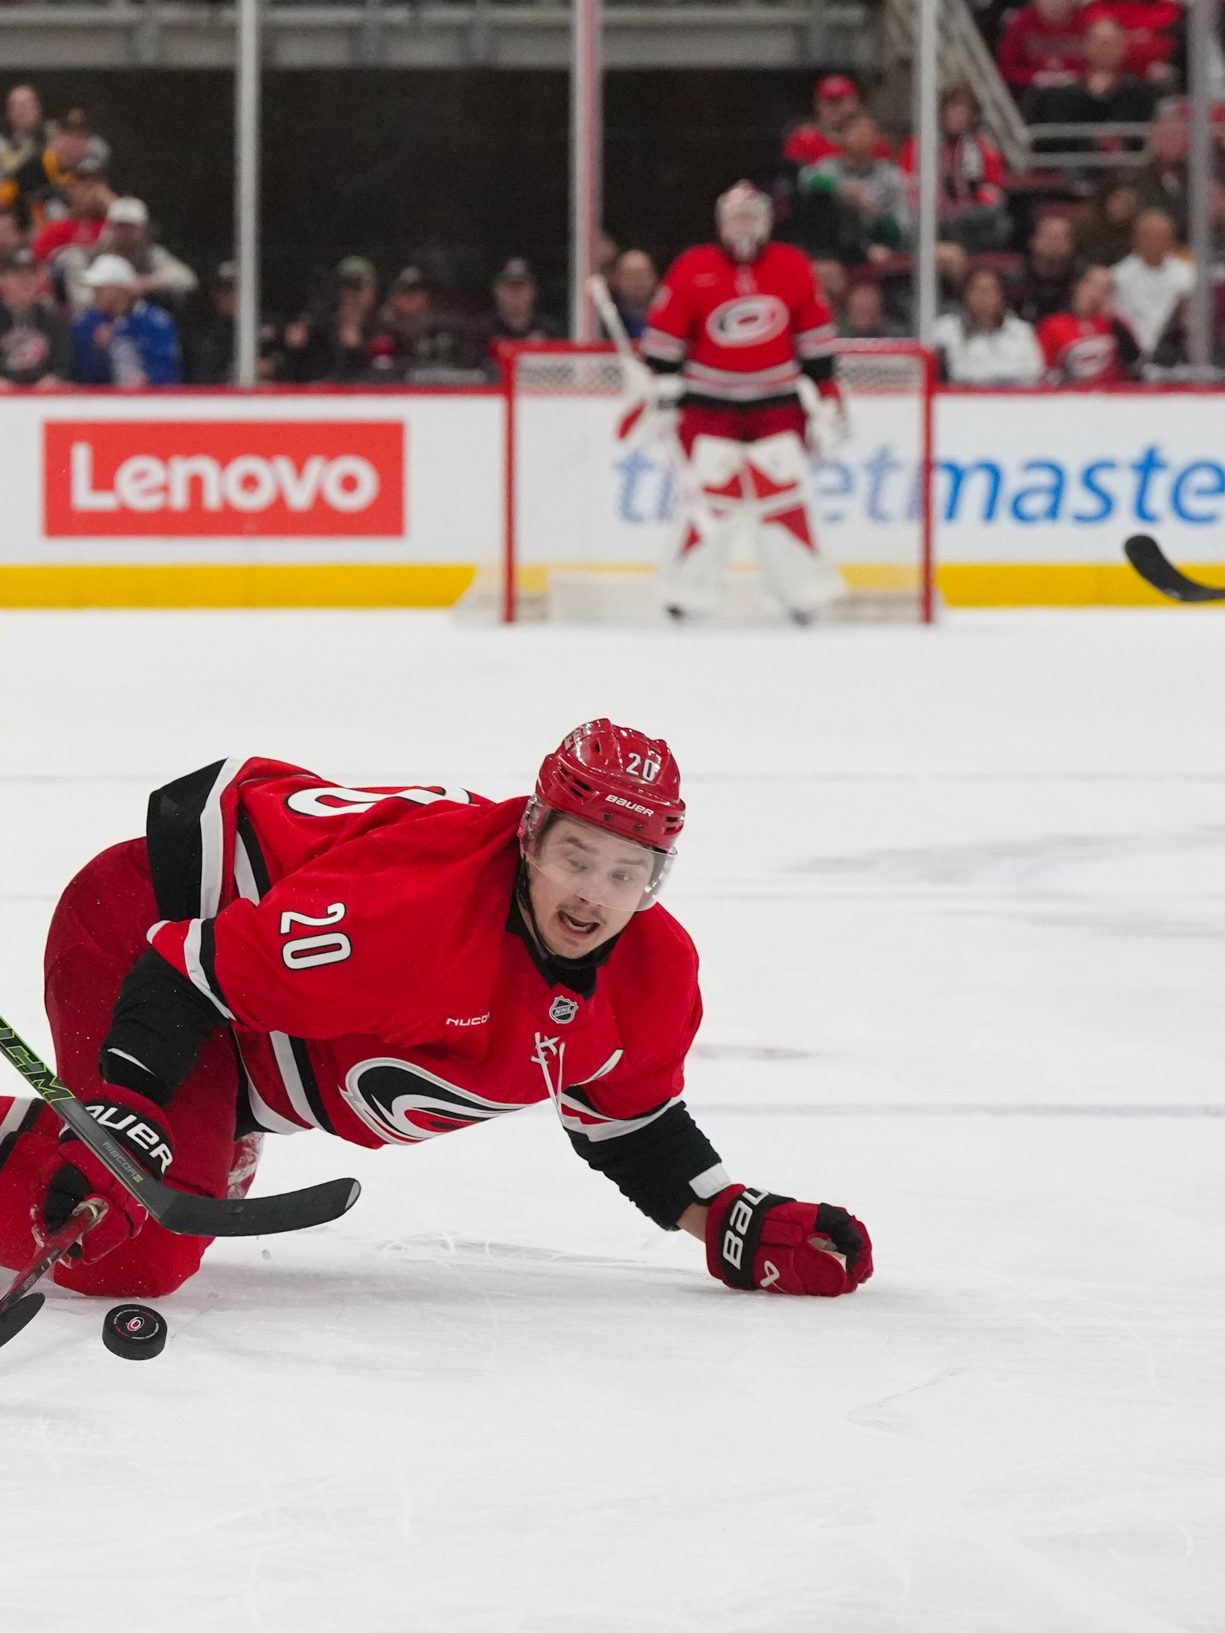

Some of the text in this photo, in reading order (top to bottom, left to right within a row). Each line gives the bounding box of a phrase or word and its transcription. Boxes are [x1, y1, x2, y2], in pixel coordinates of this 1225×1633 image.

[70, 440, 380, 513] Lenovo
[625, 752, 662, 782] 20
[605, 794, 655, 818] BAUER
[280, 902, 353, 970] 20
[445, 1011, 491, 1027] NUCO
[84, 1103, 174, 1175] AUER
